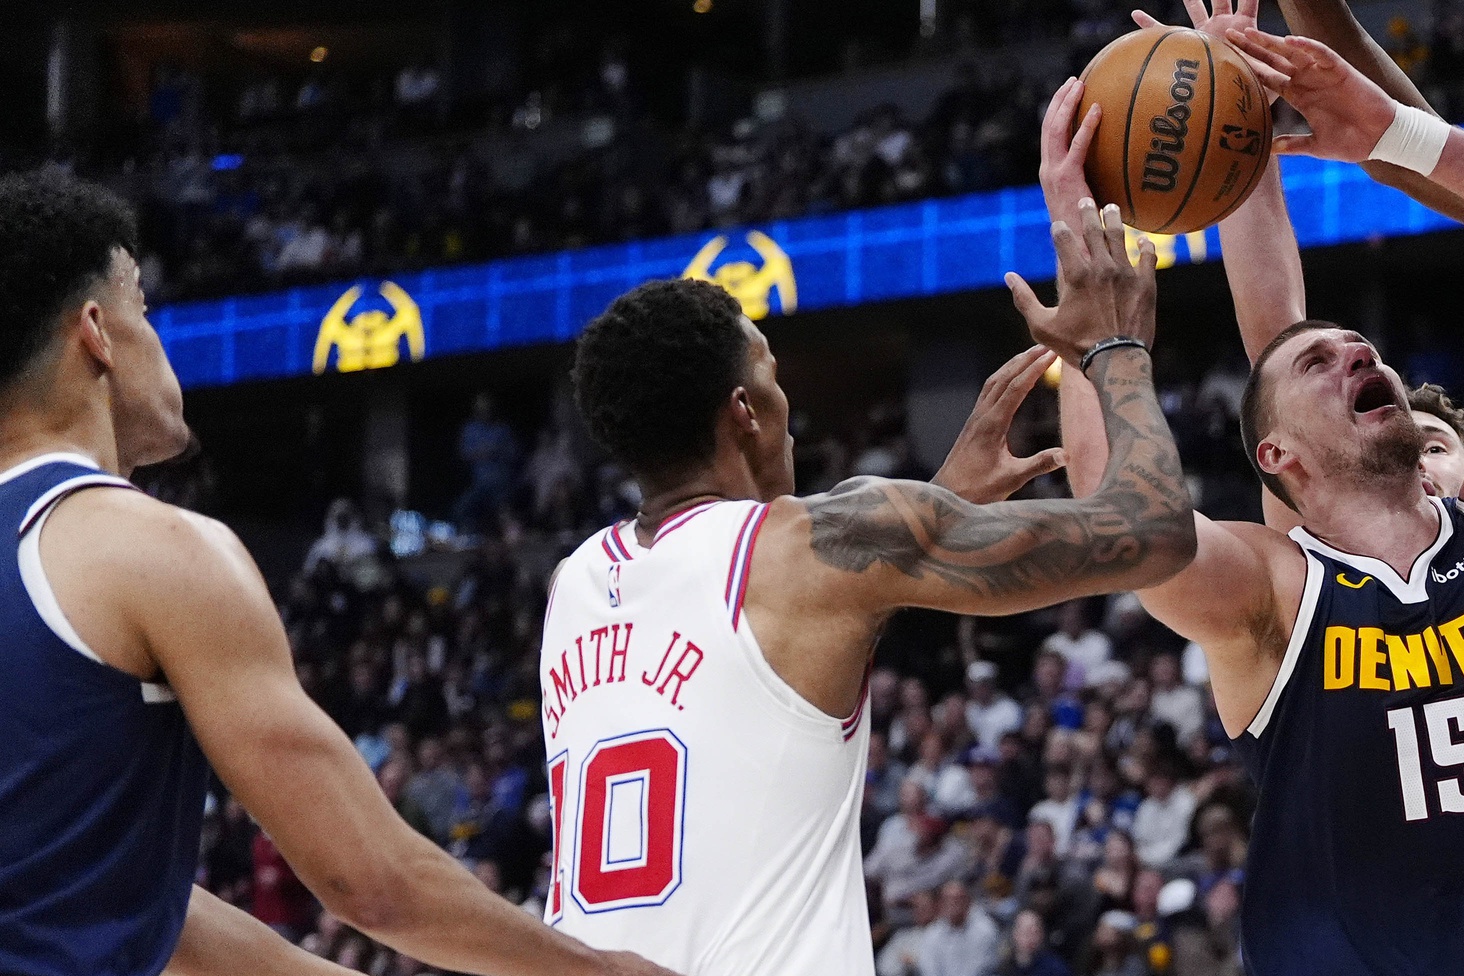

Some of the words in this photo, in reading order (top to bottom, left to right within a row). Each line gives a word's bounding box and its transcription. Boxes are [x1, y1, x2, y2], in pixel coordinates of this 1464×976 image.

[1143, 58, 1201, 193] Wilson
[544, 623, 633, 739] SMITH
[641, 631, 704, 711] JR.
[547, 728, 687, 927] 10
